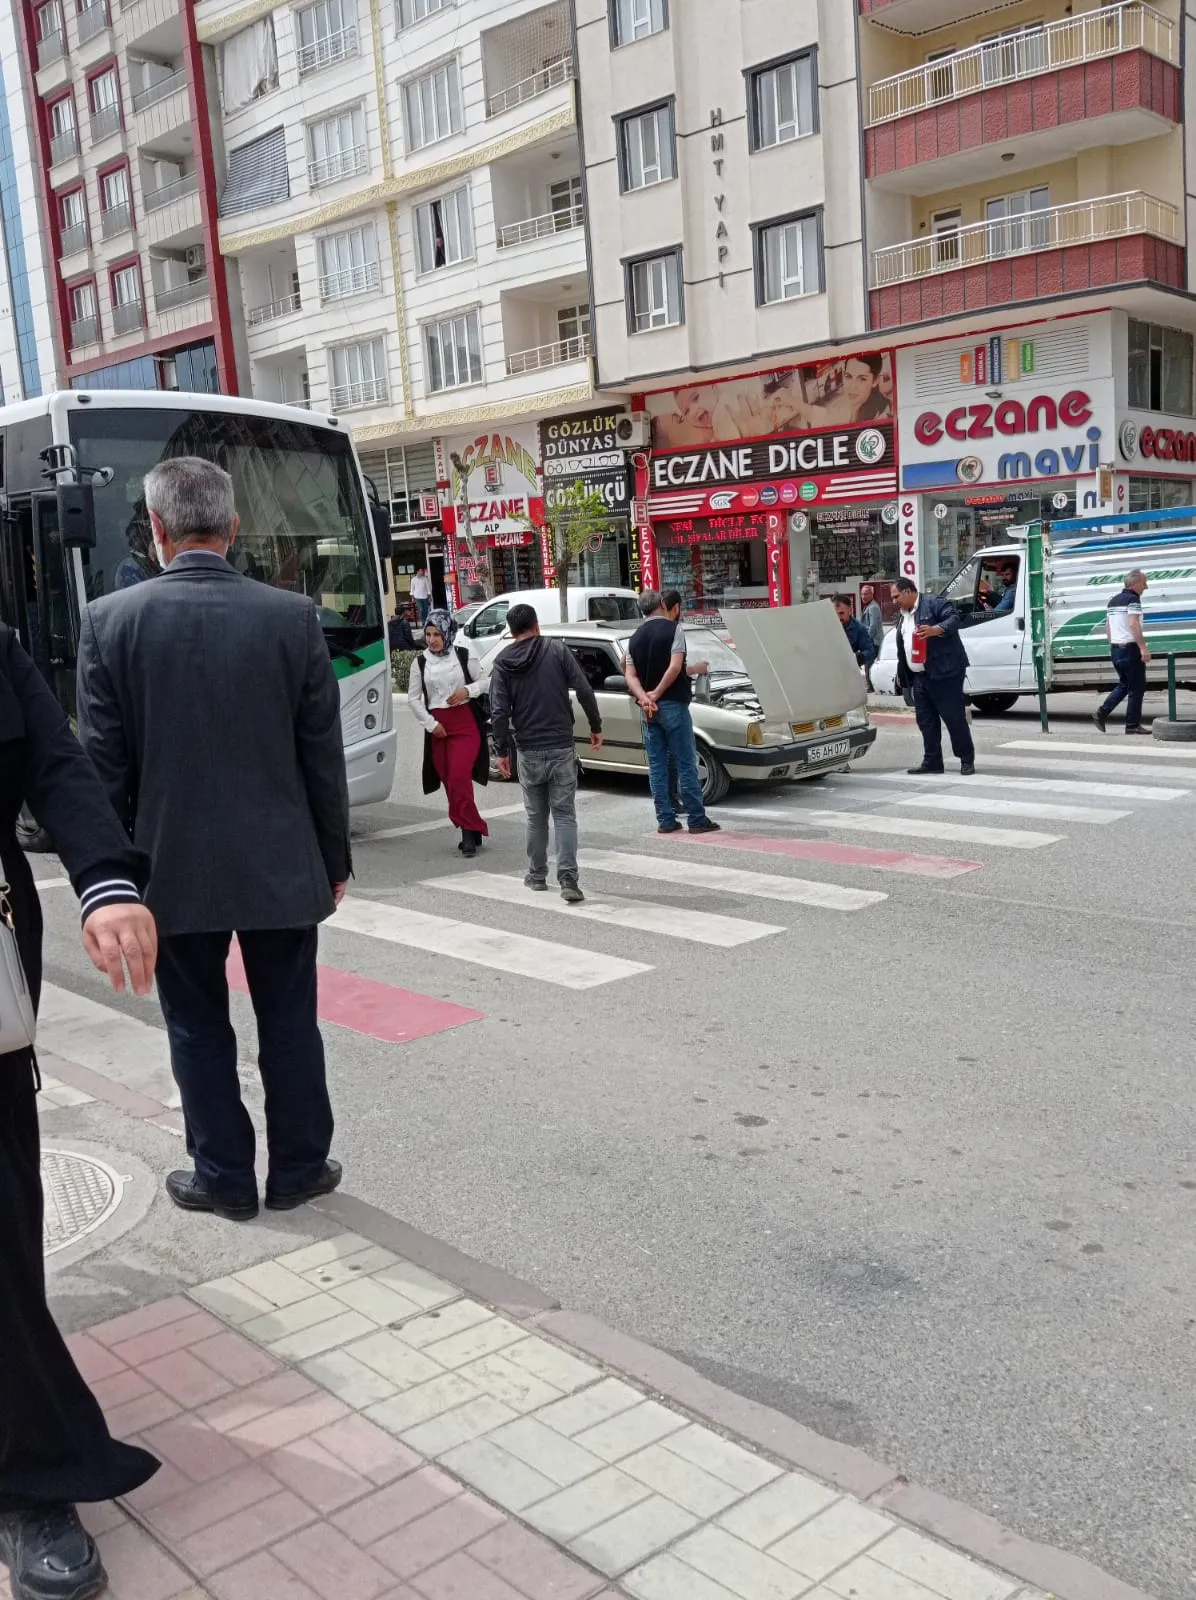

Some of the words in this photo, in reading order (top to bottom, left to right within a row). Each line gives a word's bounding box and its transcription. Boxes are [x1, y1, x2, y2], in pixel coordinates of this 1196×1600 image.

[710, 107, 724, 177] HMT
[713, 193, 729, 289] YAPI
[548, 415, 616, 438] GÖZLÜK
[914, 390, 1093, 446] eczane
[545, 433, 617, 457] DÜNYAS
[997, 426, 1102, 480] mavi
[653, 448, 753, 487] ECZANE
[484, 523, 500, 533] ALP
[494, 532, 525, 546] ECZANE
[542, 525, 550, 566] ECZANE
[901, 502, 916, 576] ecza
[811, 748, 821, 760] 56
[823, 746, 833, 758] AH
[834, 742, 848, 755] 077
